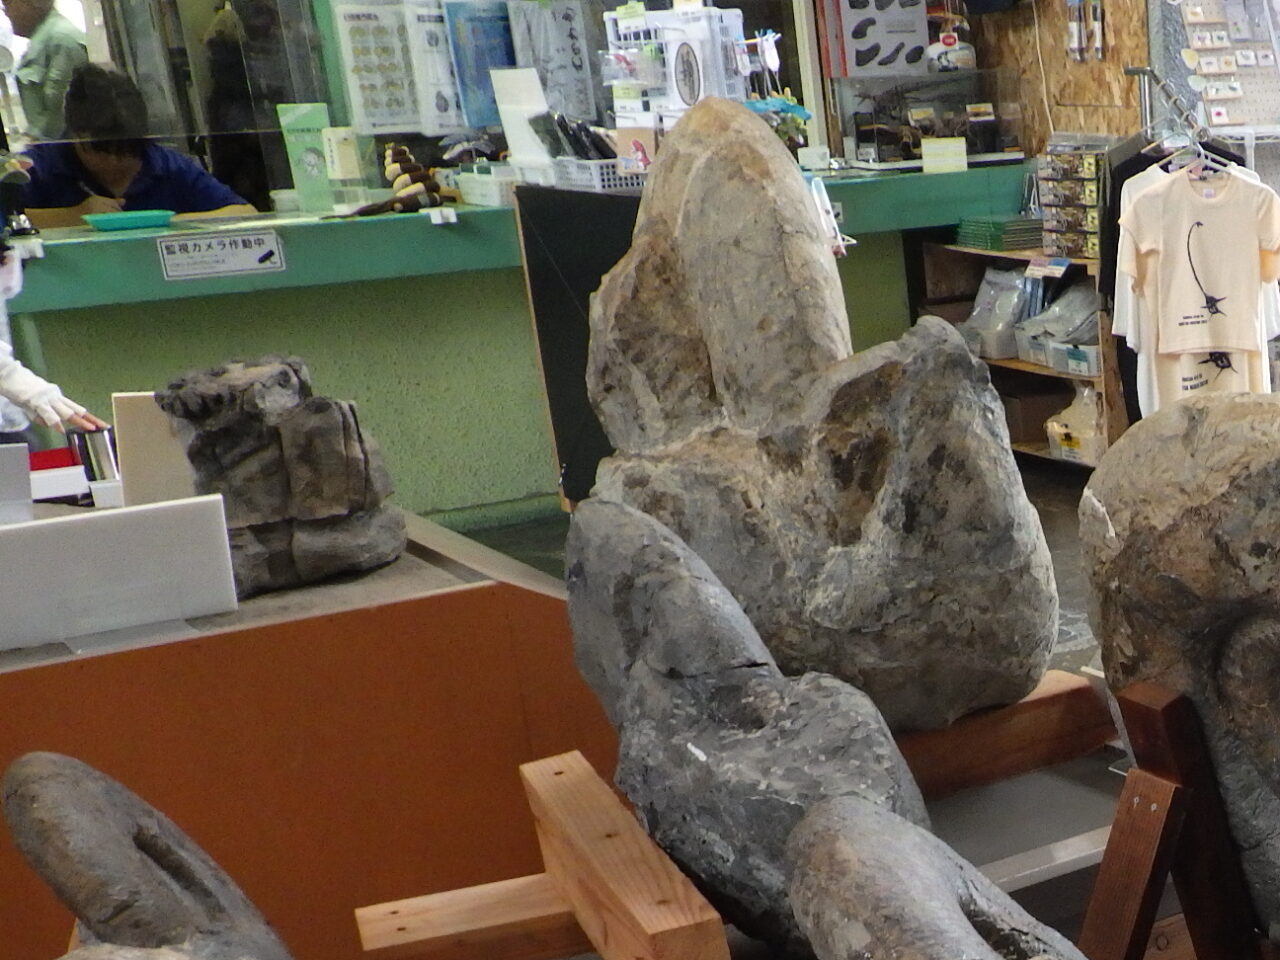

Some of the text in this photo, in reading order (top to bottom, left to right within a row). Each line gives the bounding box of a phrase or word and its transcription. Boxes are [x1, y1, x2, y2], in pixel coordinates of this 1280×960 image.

[165, 238, 265, 255] 監視カメラ作動中
